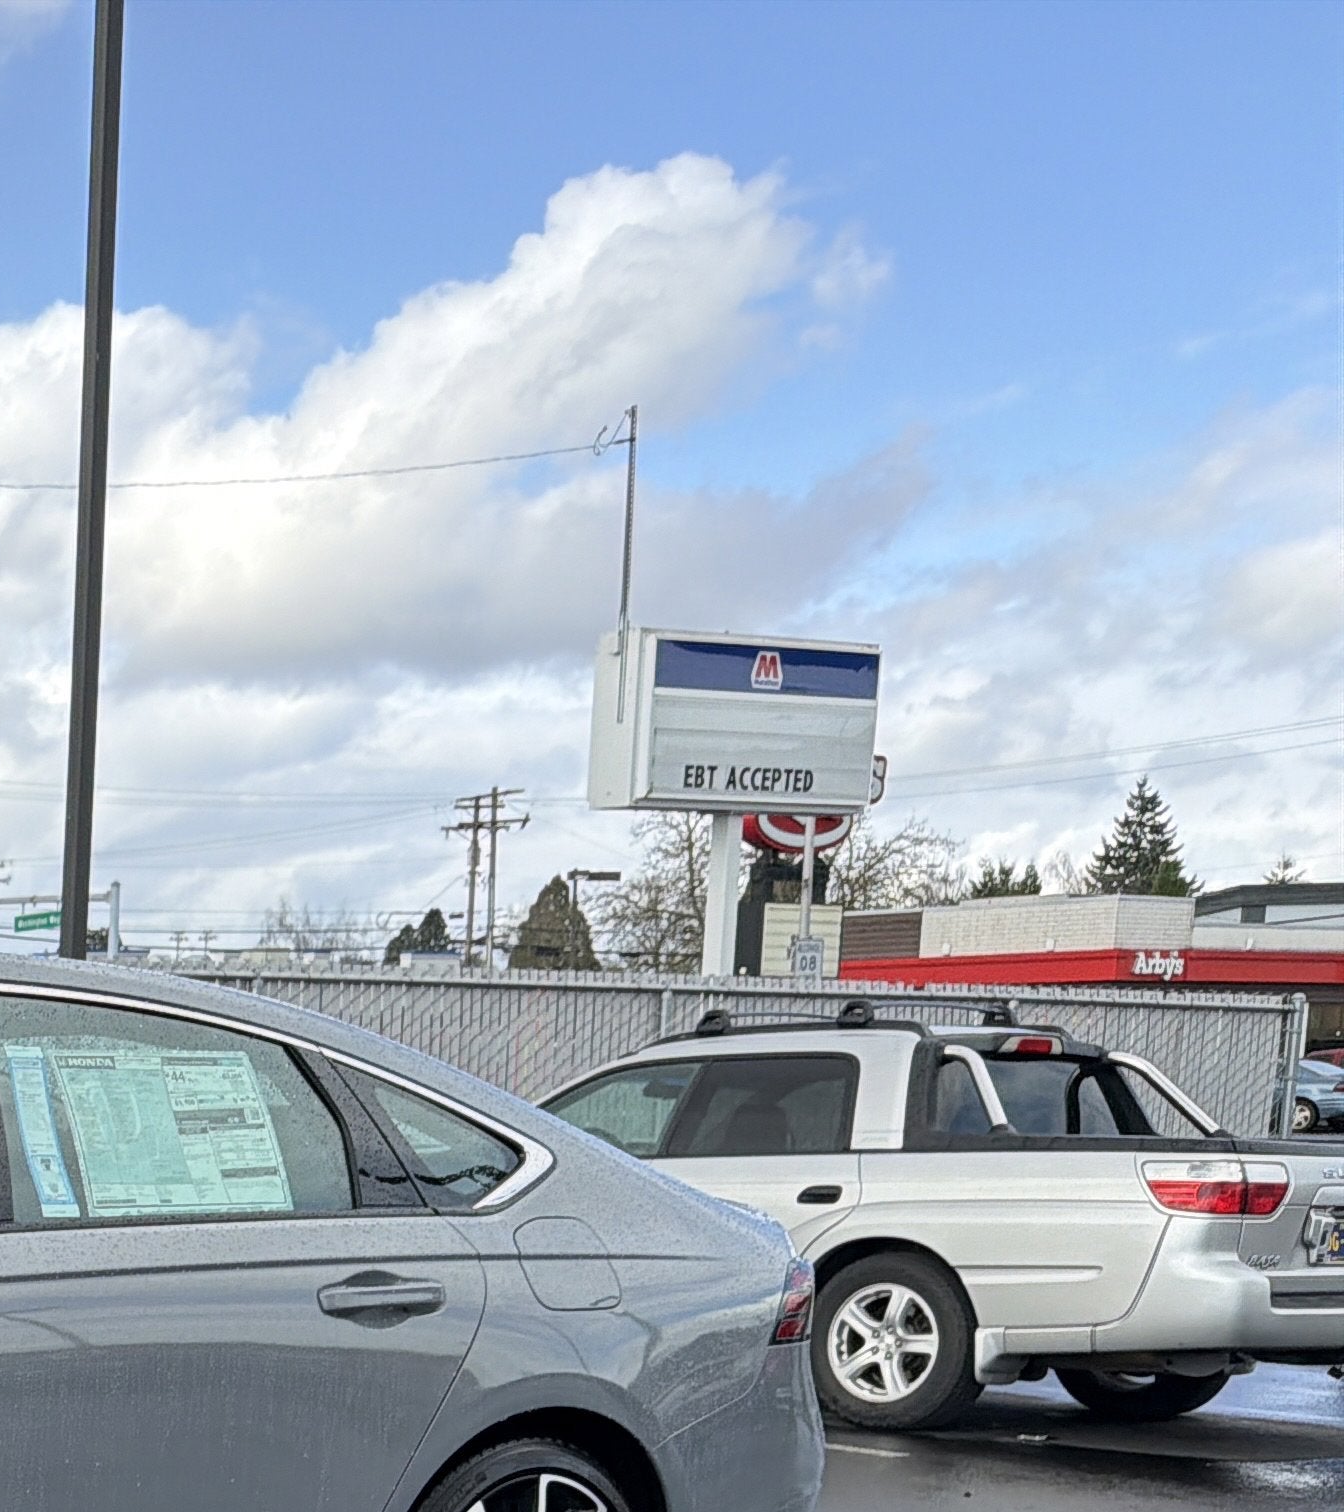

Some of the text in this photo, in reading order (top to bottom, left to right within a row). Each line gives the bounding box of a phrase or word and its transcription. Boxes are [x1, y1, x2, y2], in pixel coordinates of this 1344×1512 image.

[683, 764, 814, 793] EBT ACCEPTED
[1132, 950, 1185, 981] Arby's
[68, 1057, 114, 1067] HONDA
